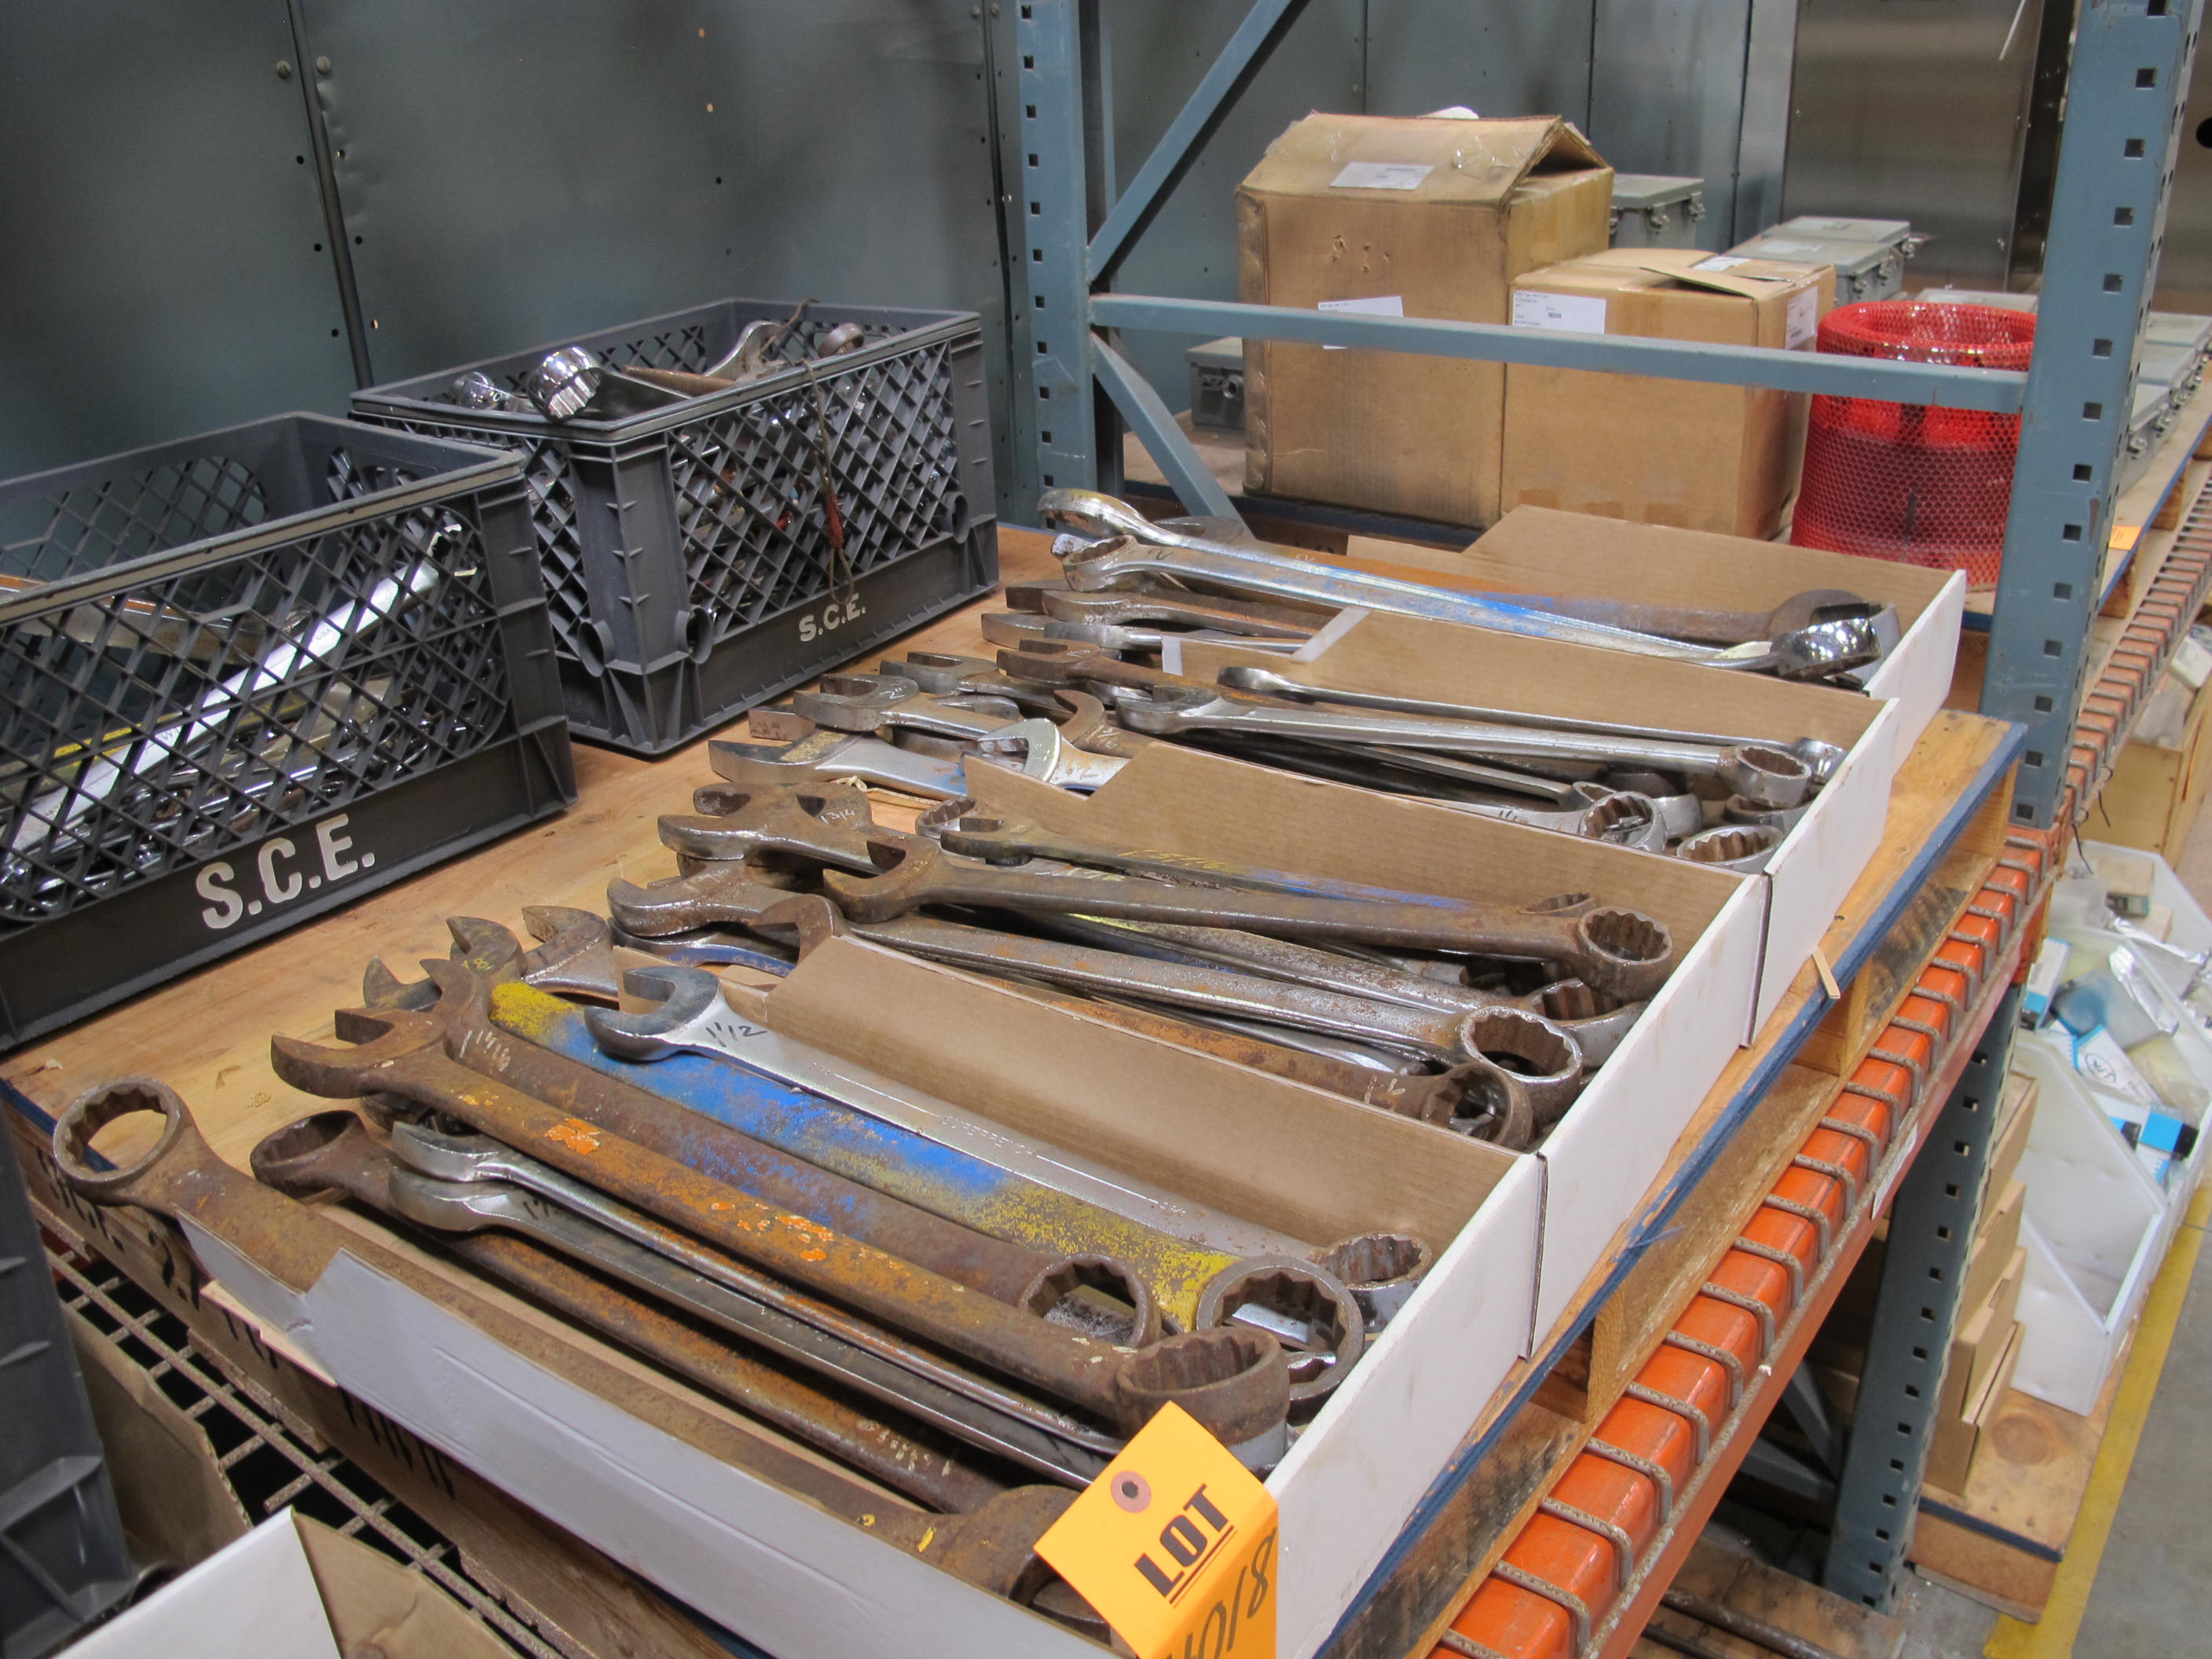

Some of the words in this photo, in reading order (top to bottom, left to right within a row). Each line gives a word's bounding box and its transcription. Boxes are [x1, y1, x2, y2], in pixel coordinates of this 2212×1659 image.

[798, 592, 866, 642] S.C.E.
[196, 813, 375, 929] S.C.E.
[1133, 1483, 1230, 1599] LOT
